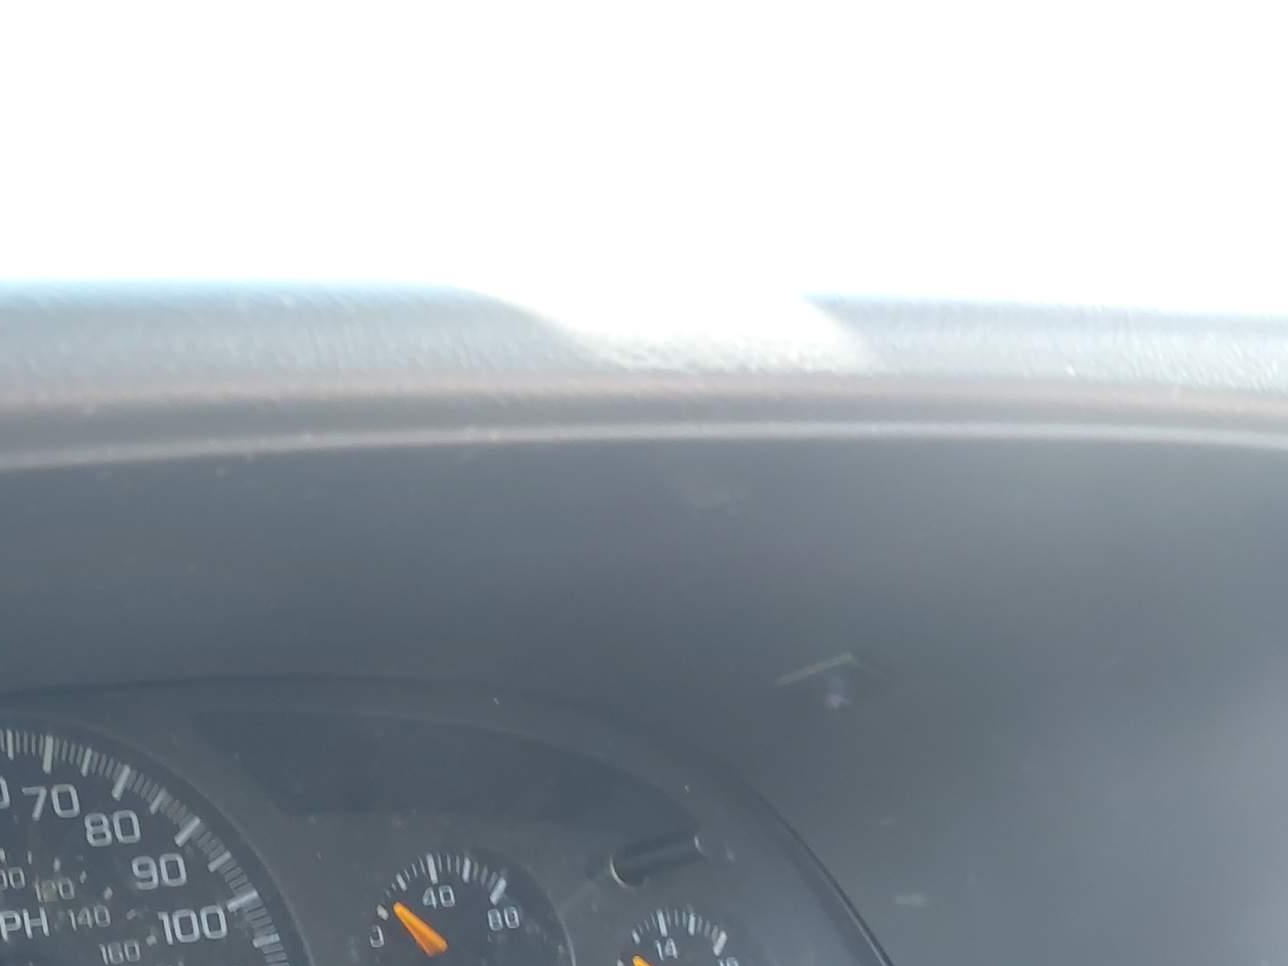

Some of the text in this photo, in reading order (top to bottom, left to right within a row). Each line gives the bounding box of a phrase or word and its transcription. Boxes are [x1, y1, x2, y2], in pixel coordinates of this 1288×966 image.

[22, 783, 81, 820] 70
[85, 808, 142, 846] 80
[132, 852, 187, 890] 90
[422, 885, 456, 909] 40
[67, 904, 112, 931] 140
[158, 906, 229, 946] 100
[656, 938, 678, 961] 14
